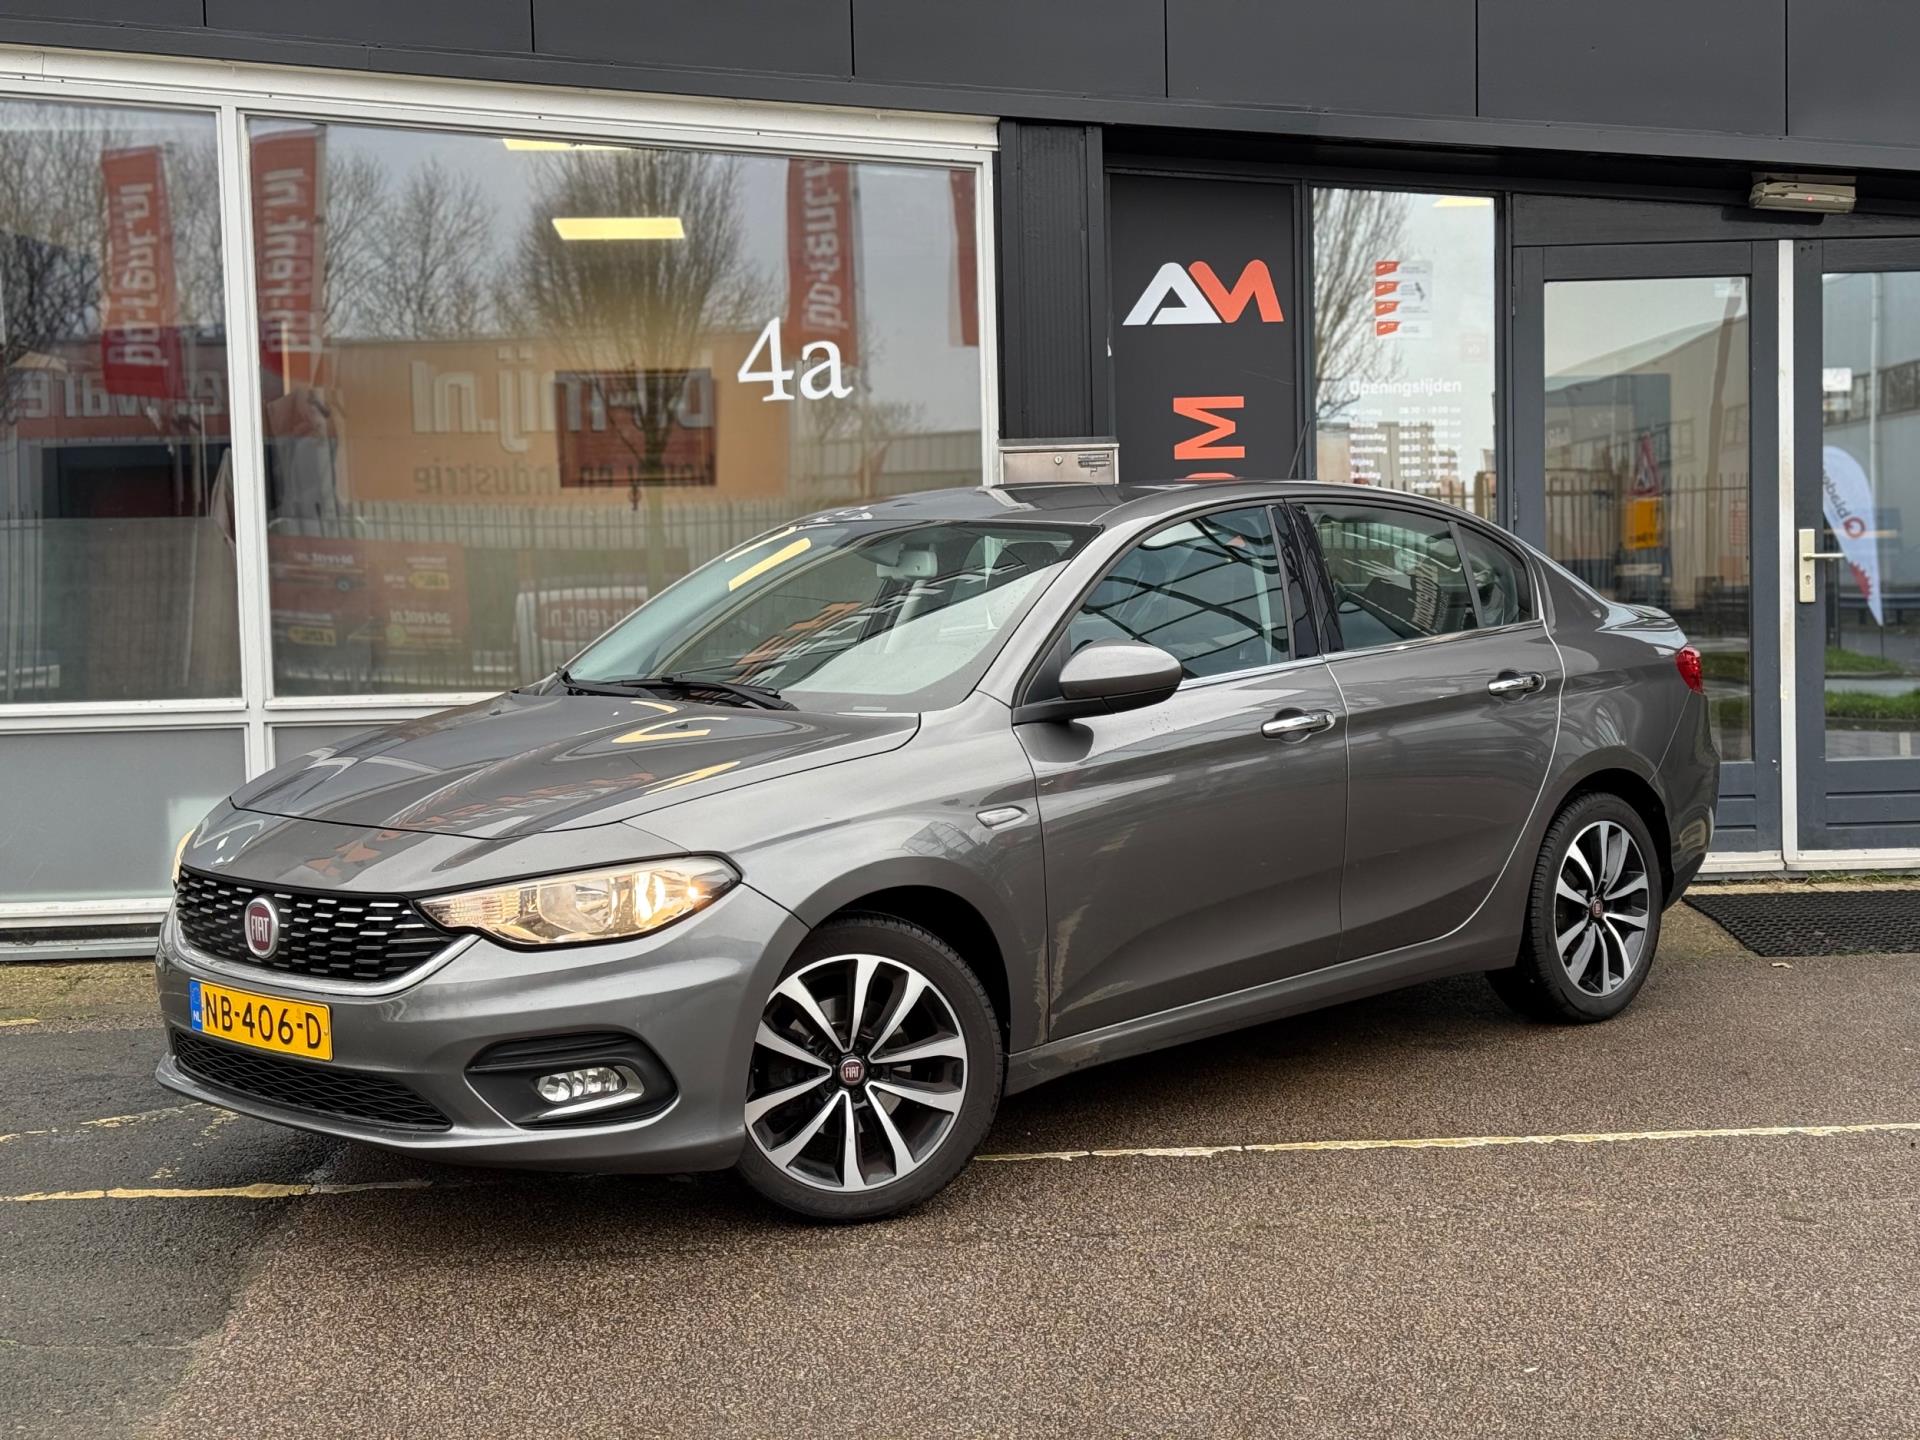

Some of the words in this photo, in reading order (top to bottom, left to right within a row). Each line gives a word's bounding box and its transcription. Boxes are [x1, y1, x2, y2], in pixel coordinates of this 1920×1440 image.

[1122, 259, 1285, 326] AM
[737, 317, 853, 402] 4a
[1173, 395, 1245, 479] M
[251, 915, 270, 942] FIAT
[203, 990, 322, 1050] NB-406-D
[845, 1066, 860, 1078] FIAT
